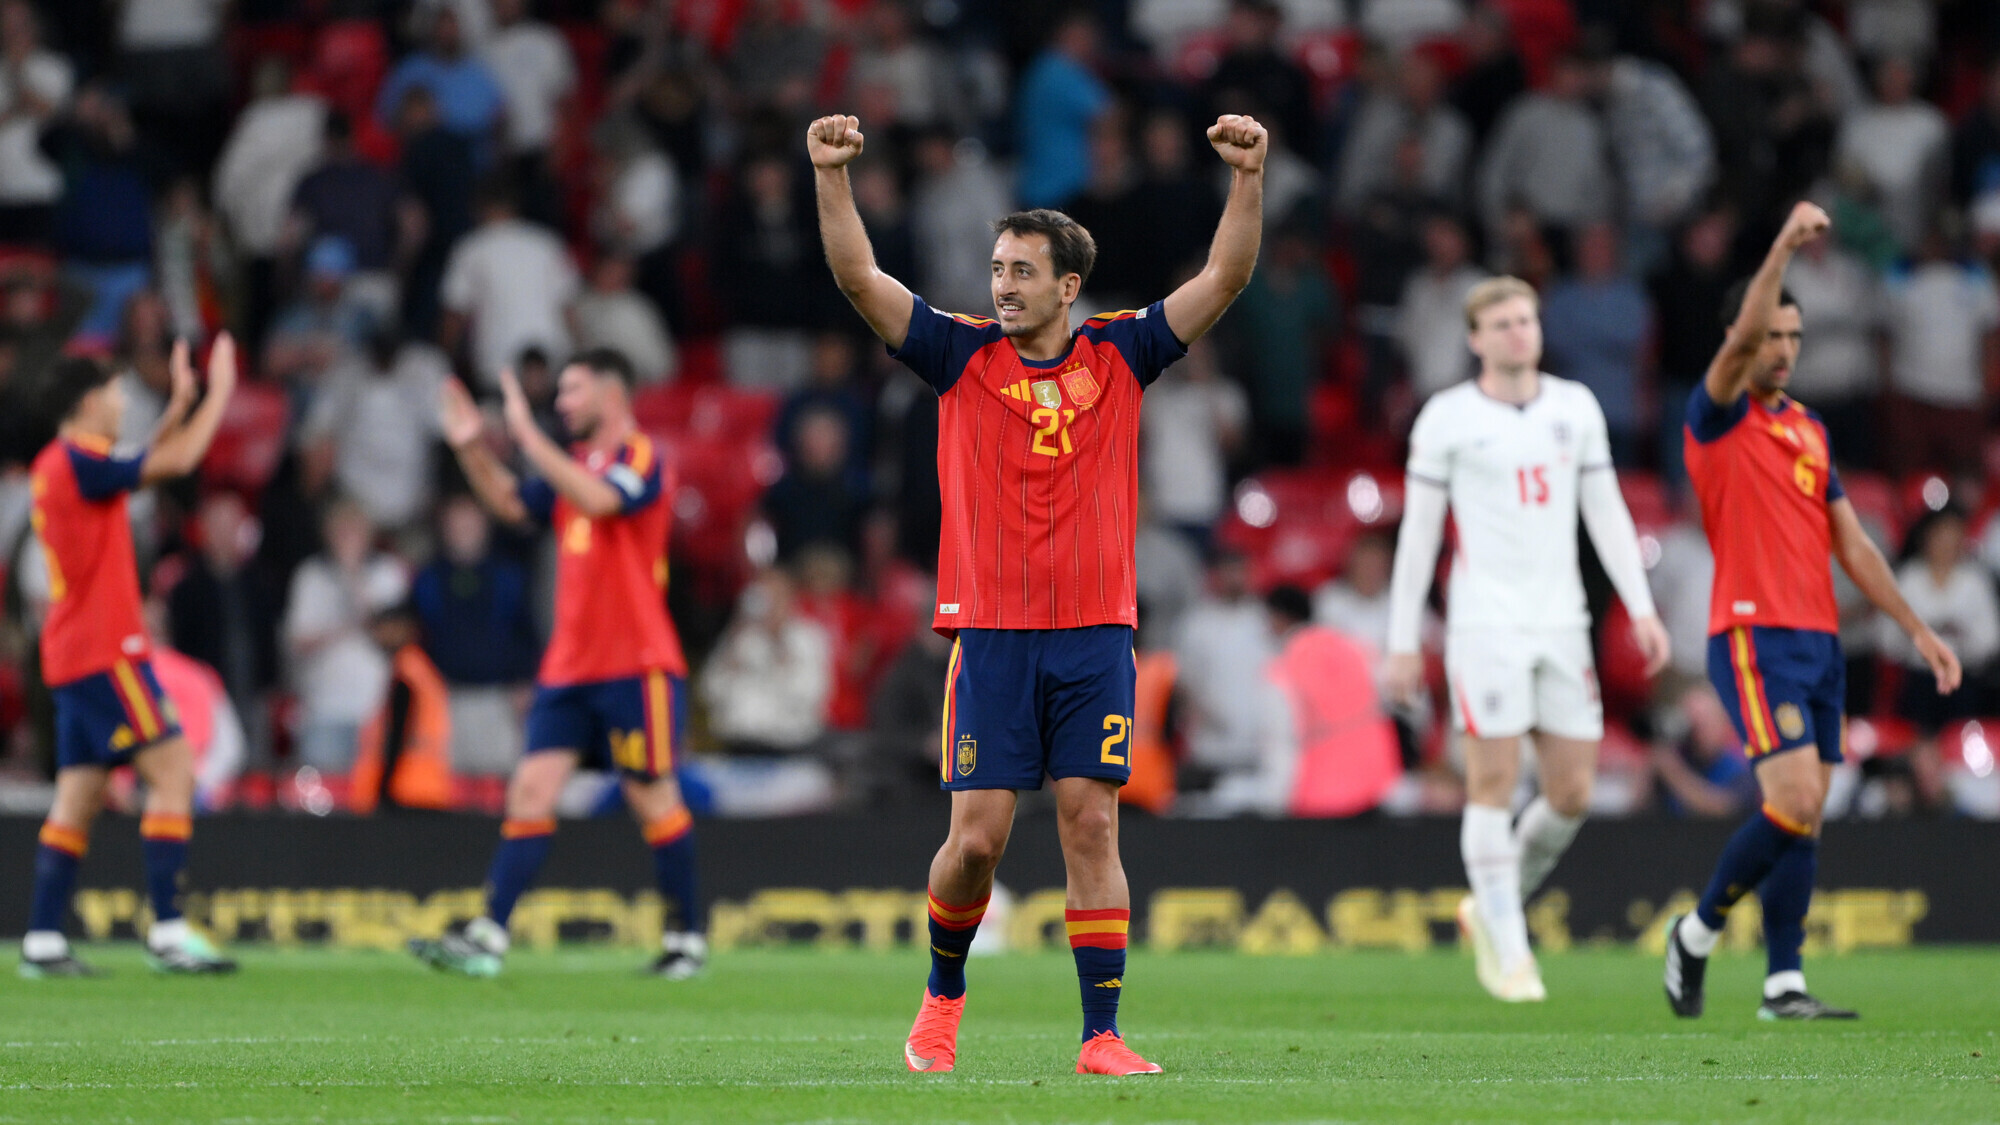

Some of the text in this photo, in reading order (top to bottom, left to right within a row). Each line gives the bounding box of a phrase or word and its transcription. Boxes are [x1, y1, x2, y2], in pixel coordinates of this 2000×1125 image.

[1031, 408, 1075, 457] 21
[1517, 464, 1550, 506] 15
[1794, 454, 1816, 497] 6
[1101, 714, 1132, 767] 21
